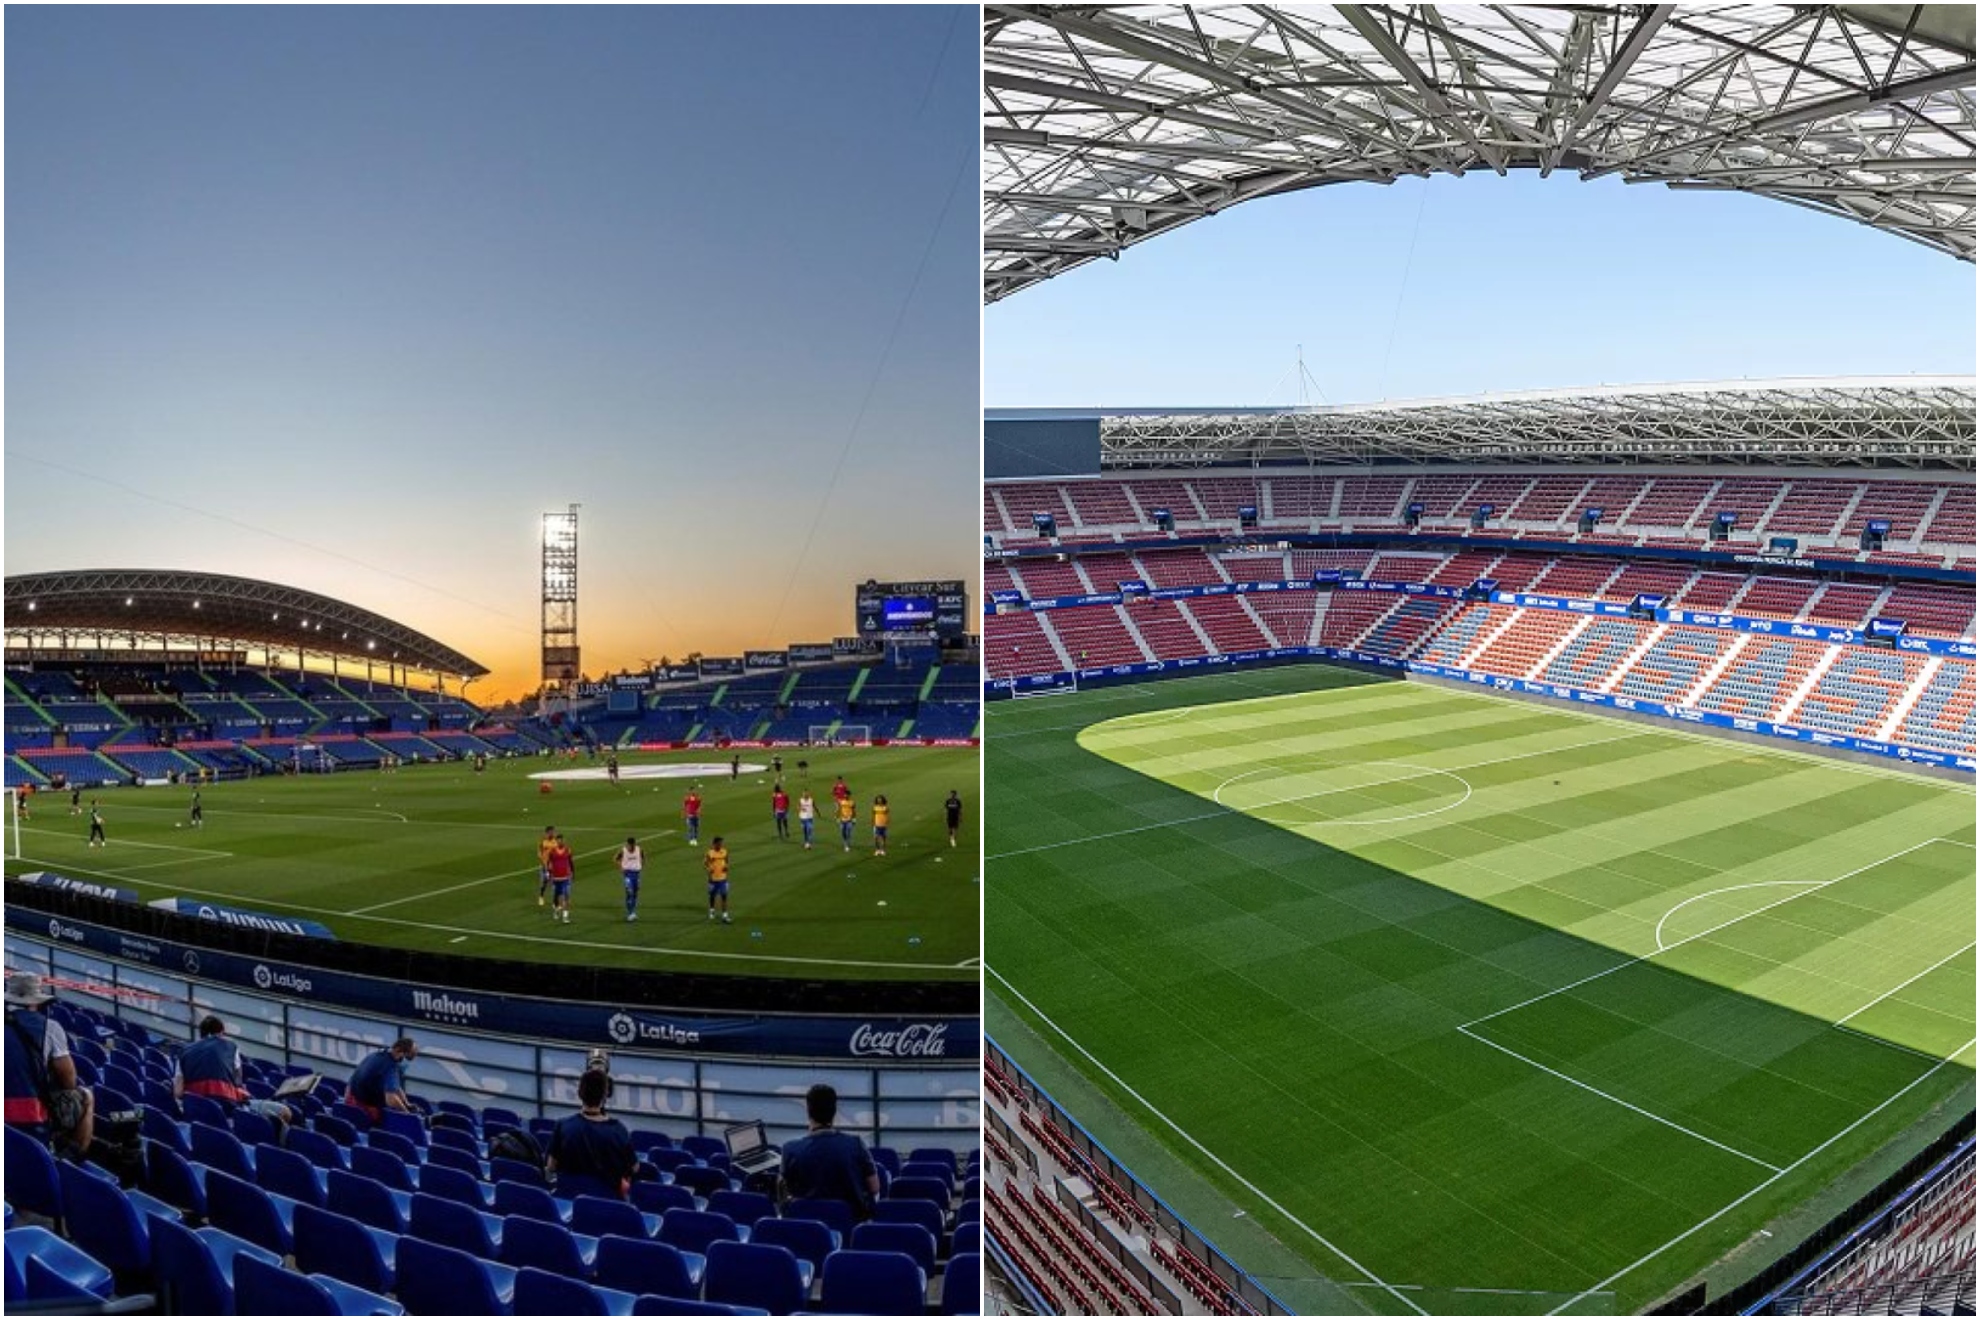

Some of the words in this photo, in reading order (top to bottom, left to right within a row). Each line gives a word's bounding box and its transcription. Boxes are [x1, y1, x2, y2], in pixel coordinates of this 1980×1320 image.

[273, 972, 311, 991] LaLiga
[412, 990, 478, 1018] Mahou
[639, 1023, 699, 1043] LaLiga
[850, 1024, 948, 1056] Coca-Cola
